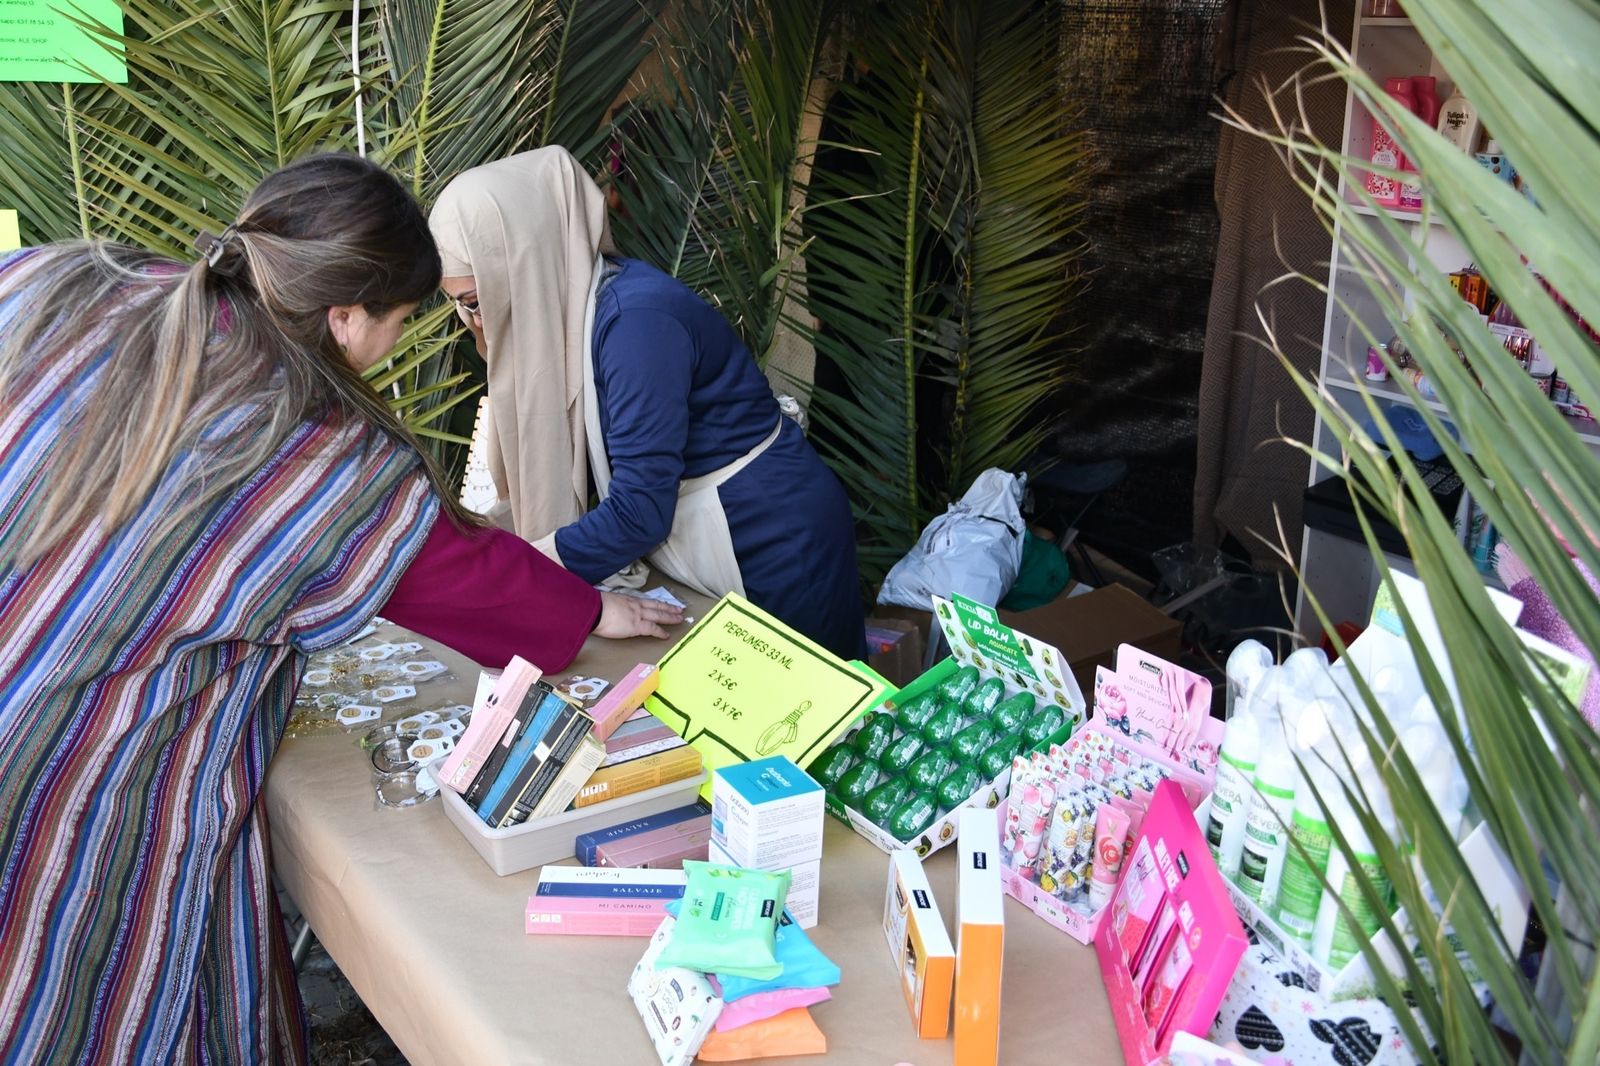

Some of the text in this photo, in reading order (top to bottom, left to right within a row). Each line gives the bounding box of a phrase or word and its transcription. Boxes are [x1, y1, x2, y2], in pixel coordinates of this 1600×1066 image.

[723, 621, 793, 670] PERFUMES 33 ML
[967, 618, 1009, 644] LIP BALM
